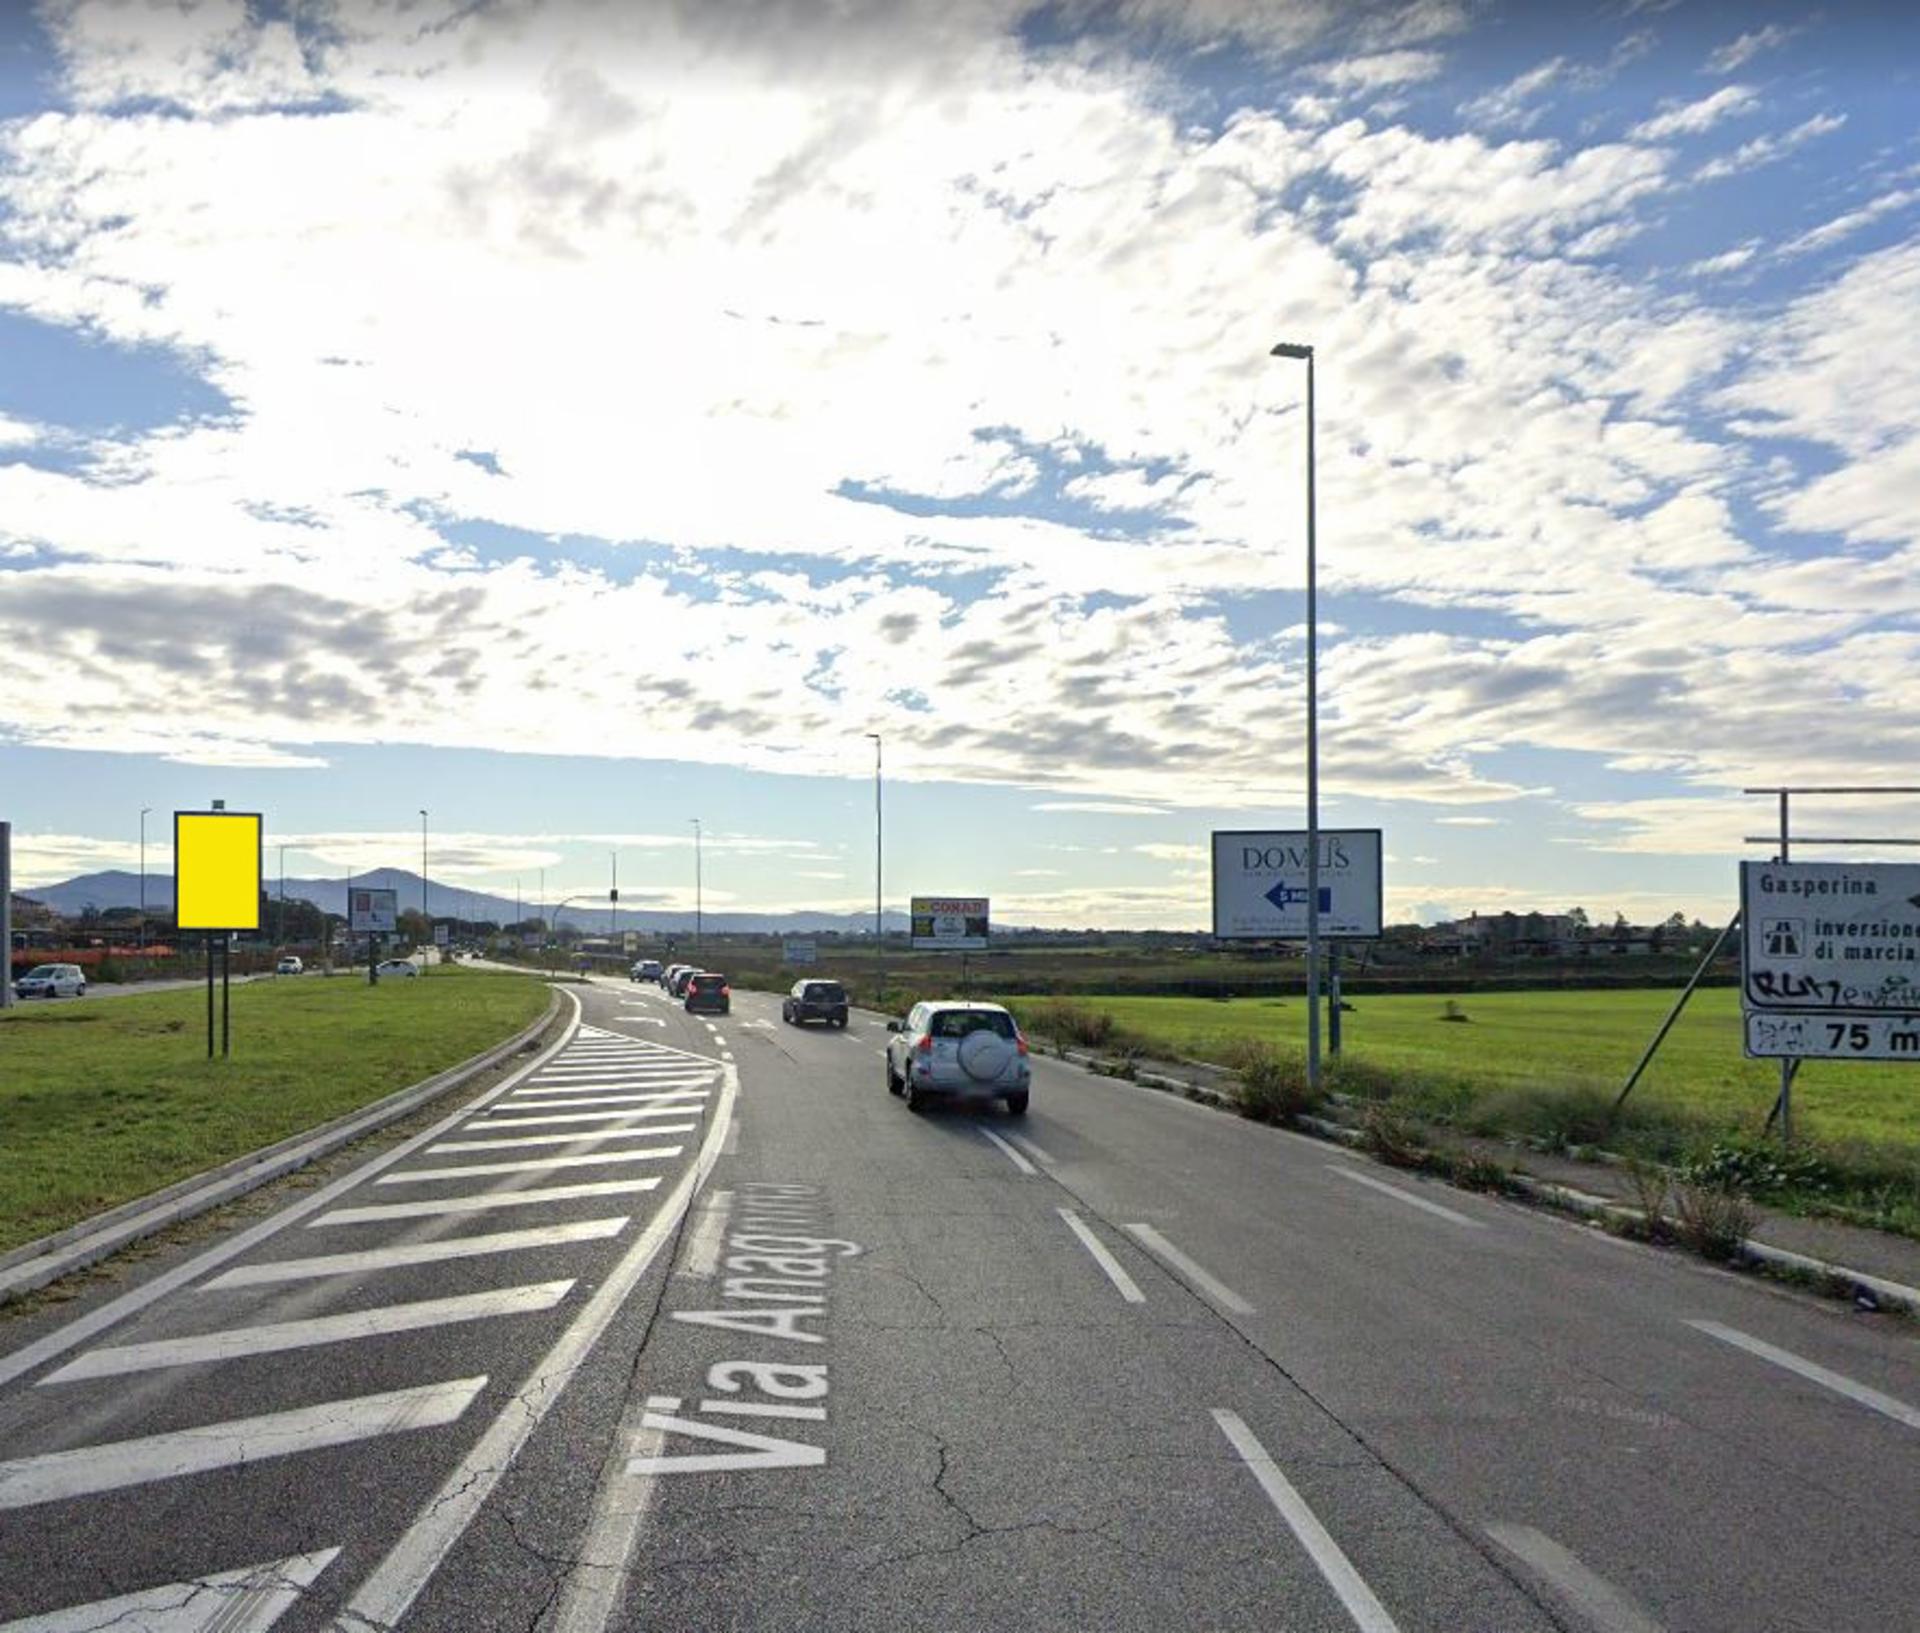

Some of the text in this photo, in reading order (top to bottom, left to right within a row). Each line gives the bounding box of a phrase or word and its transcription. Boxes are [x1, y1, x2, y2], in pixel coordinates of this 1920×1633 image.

[1760, 874, 1878, 898] Gasperina
[1815, 940, 1915, 961] di marcia
[1826, 1024, 1870, 1051] 75
[1890, 1031, 1920, 1051] m
